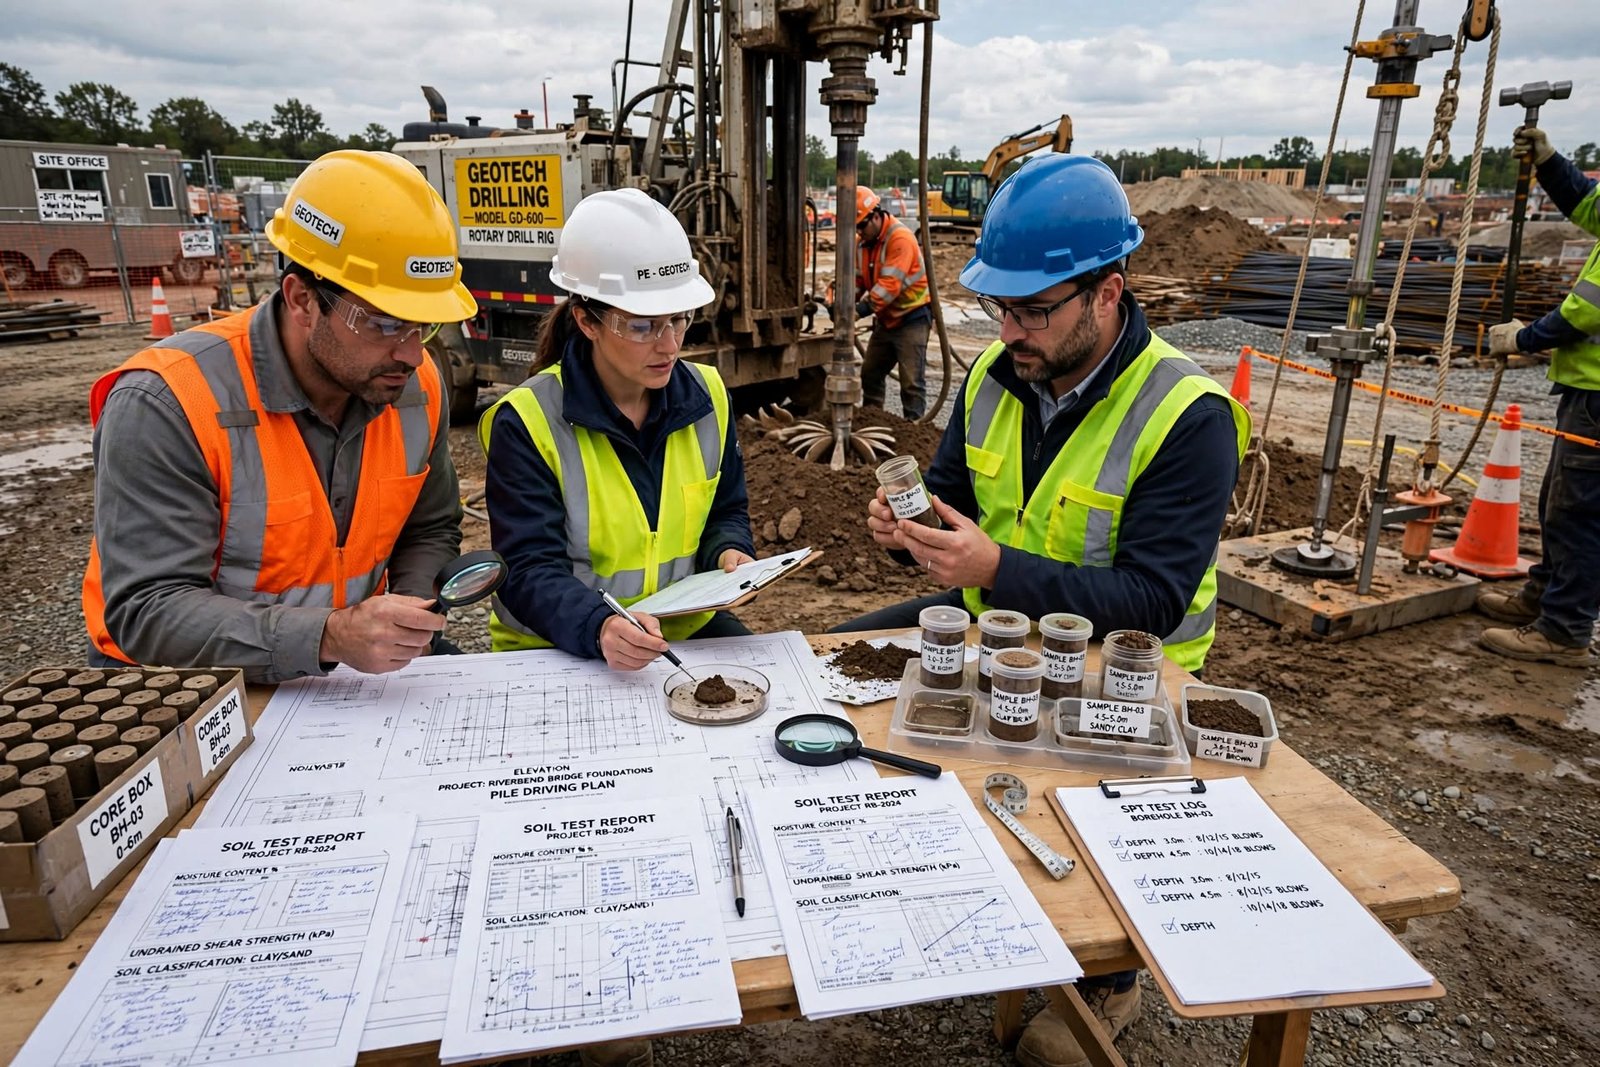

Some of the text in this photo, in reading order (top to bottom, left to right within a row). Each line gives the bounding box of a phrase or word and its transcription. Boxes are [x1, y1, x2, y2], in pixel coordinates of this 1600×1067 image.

[39, 155, 106, 167] SITE OFFICE
[468, 160, 547, 183] GEOTECH
[469, 185, 549, 208] DRILLING
[294, 204, 340, 241] GEOTECH
[474, 211, 544, 224] MODEL GD-600
[469, 229, 554, 244] ROTARY DRILL RIG
[410, 260, 454, 273] GEOTECH
[637, 268, 651, 280] PE
[658, 261, 690, 276] GEOTECH
[1043, 651, 1067, 663] SAMPLE
[1109, 669, 1134, 681] SAMPLE
[993, 690, 1018, 704] SAMPLE
[1087, 701, 1144, 714] SAMPLE BH-03
[198, 695, 238, 741] CORE BOX
[1094, 713, 1128, 723] 4.5-5.0m
[1090, 722, 1137, 734] SANDY CLAY
[209, 722, 231, 752] BH-03
[1201, 734, 1258, 748] SAMPLE BH-03
[212, 743, 231, 766] 0-6m
[1226, 752, 1253, 762] BROWN
[438, 766, 653, 791] PROJECT: RIVERBEND BRIDGE FOUNDATIONS
[513, 765, 571, 776] ELEVATION
[490, 787, 519, 800] PILE
[523, 783, 577, 798] DRIVING
[580, 779, 616, 792] PLAN
[90, 772, 153, 838] CORE BOX
[794, 788, 917, 808] SOIL TEST REPORT
[819, 800, 902, 814] PROJECT RB-2024
[1120, 800, 1207, 814] SPT TEST LOG
[110, 804, 144, 844] BH-03
[523, 813, 656, 834] SOIL TEST REPORT
[1130, 810, 1213, 822] BOREHOLE BH-03
[773, 822, 815, 832] MOISTURE
[818, 818, 856, 828] CONTENT
[221, 831, 365, 852] SOIL TEST REPORT
[546, 827, 635, 840] PROJECT RB-2024
[1125, 838, 1156, 847] DEPTH
[1163, 836, 1185, 845] 3.0m
[1196, 833, 1229, 843] 8/12/15
[1231, 831, 1264, 840] BLOWS
[116, 829, 143, 860] 0-6m
[241, 844, 337, 859] PROJECT RB-2024
[1133, 851, 1165, 860] DEPTH
[1169, 849, 1191, 858] 4.5m
[1204, 845, 1242, 857] 10/14/18
[1243, 844, 1276, 853] BLOWS
[493, 850, 535, 860] MOISTURE
[537, 847, 575, 857] CONTENT
[175, 870, 222, 881] MOISTURE
[224, 867, 268, 876] CONTENT
[856, 869, 887, 880] SHEAR
[889, 864, 937, 876] STRENGTH
[938, 861, 960, 872] (kPa)
[1151, 877, 1185, 887] DEPTH
[1191, 875, 1214, 884] 3.0m
[1225, 871, 1261, 882] 8/12/15
[796, 898, 819, 908] SOIL
[821, 888, 903, 905] CLASSIFICATION:
[1161, 892, 1195, 902] DEPTH
[1200, 890, 1222, 899] 4.5m
[1237, 886, 1273, 898] 8/12/15
[1275, 884, 1309, 894] BLOWS
[1246, 900, 1288, 913] 10/14/18
[1289, 899, 1324, 909] BLOWS
[486, 915, 507, 926] SOIL
[510, 908, 588, 924] CLASSIFICATION:
[1180, 920, 1216, 932] DEPTH
[129, 929, 335, 958] UNDRAINED SHEAR STRENGTH (kPa)
[113, 949, 313, 978] SOIL CLASSIFICATION: CLAY/SAND
